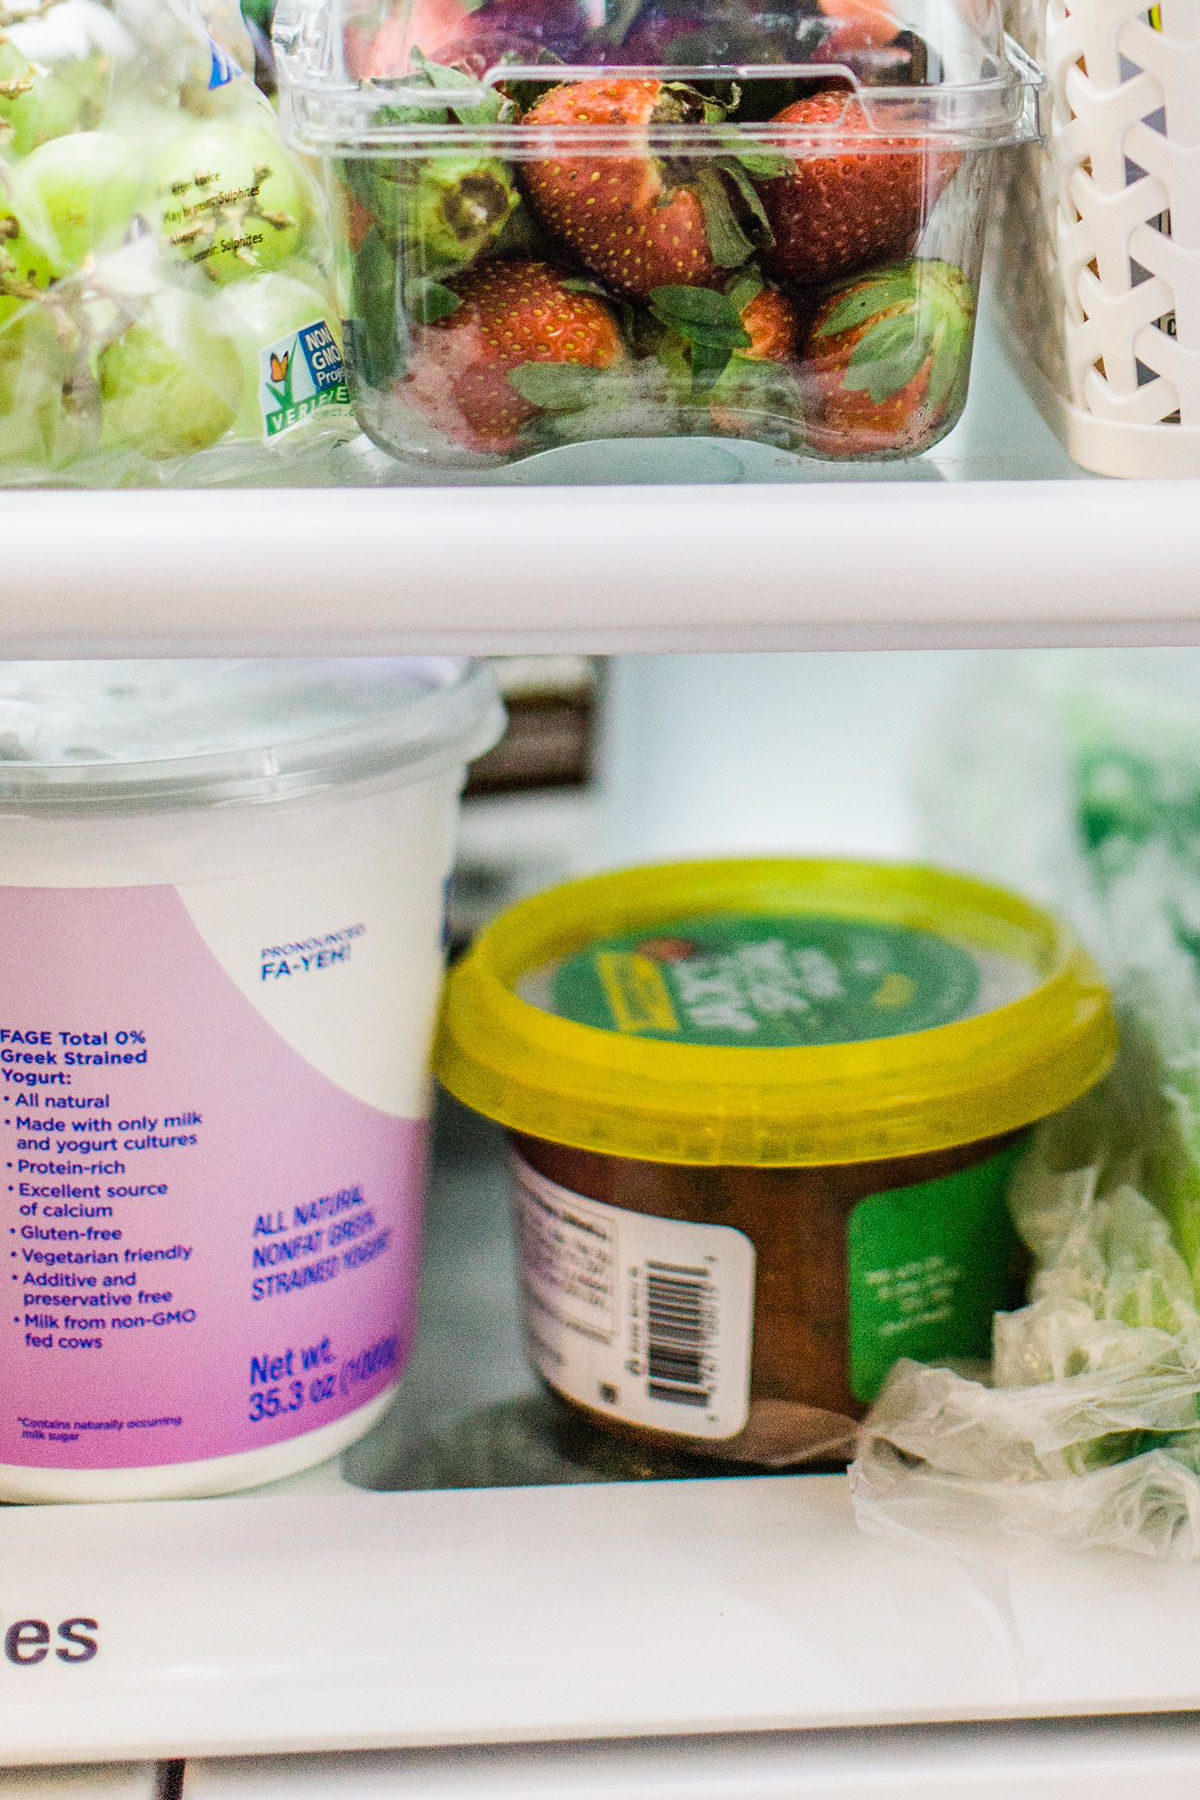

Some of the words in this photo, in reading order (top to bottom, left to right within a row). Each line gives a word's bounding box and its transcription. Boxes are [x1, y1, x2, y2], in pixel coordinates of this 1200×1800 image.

[219, 185, 260, 206] Sulphites
[221, 232, 264, 254] Sulphites
[304, 326, 332, 351] NON
[311, 344, 341, 370] GMO
[272, 386, 349, 430] VERIFIE
[0, 1029, 52, 1044] FAGE
[59, 1032, 107, 1045] Total
[115, 1030, 146, 1045] 0%
[0, 1049, 57, 1065] Greek
[64, 1049, 147, 1065] Strained
[1, 1068, 71, 1086] Yogurt:
[15, 1093, 39, 1107] All
[45, 1093, 110, 1108] natural
[16, 1116, 66, 1131] Made
[72, 1118, 112, 1132] with
[118, 1116, 158, 1132] only
[164, 1112, 203, 1128] milk
[17, 1137, 50, 1150] and
[56, 1138, 118, 1154] yogurt
[123, 1134, 197, 1150] cultures
[18, 1159, 126, 1175] Protein-rich
[19, 1182, 101, 1198] Excellent
[107, 1183, 168, 1198] source
[19, 1202, 38, 1216] of
[43, 1203, 113, 1218] calcium
[253, 1210, 287, 1238] ALL
[293, 1183, 364, 1227] NATURAL
[21, 1225, 123, 1241] Gluten-free
[22, 1248, 119, 1266] Vegetarian
[124, 1245, 193, 1263] friendly
[253, 1229, 323, 1269] NONFAT
[23, 1272, 97, 1287] Additive
[103, 1272, 137, 1287] and
[251, 1255, 340, 1301] STRAINED
[23, 1292, 133, 1306] preservative
[138, 1290, 173, 1304] free
[25, 1314, 59, 1328] Milk
[64, 1315, 106, 1329] from
[111, 1308, 197, 1328] non-GMO
[25, 1332, 53, 1348] fed
[58, 1336, 104, 1349] cows
[251, 1350, 293, 1385] Net
[249, 1380, 304, 1422] 35.3
[309, 1374, 335, 1403] oz
[73, 1420, 123, 1432] naturally
[4, 1616, 99, 1666] es
